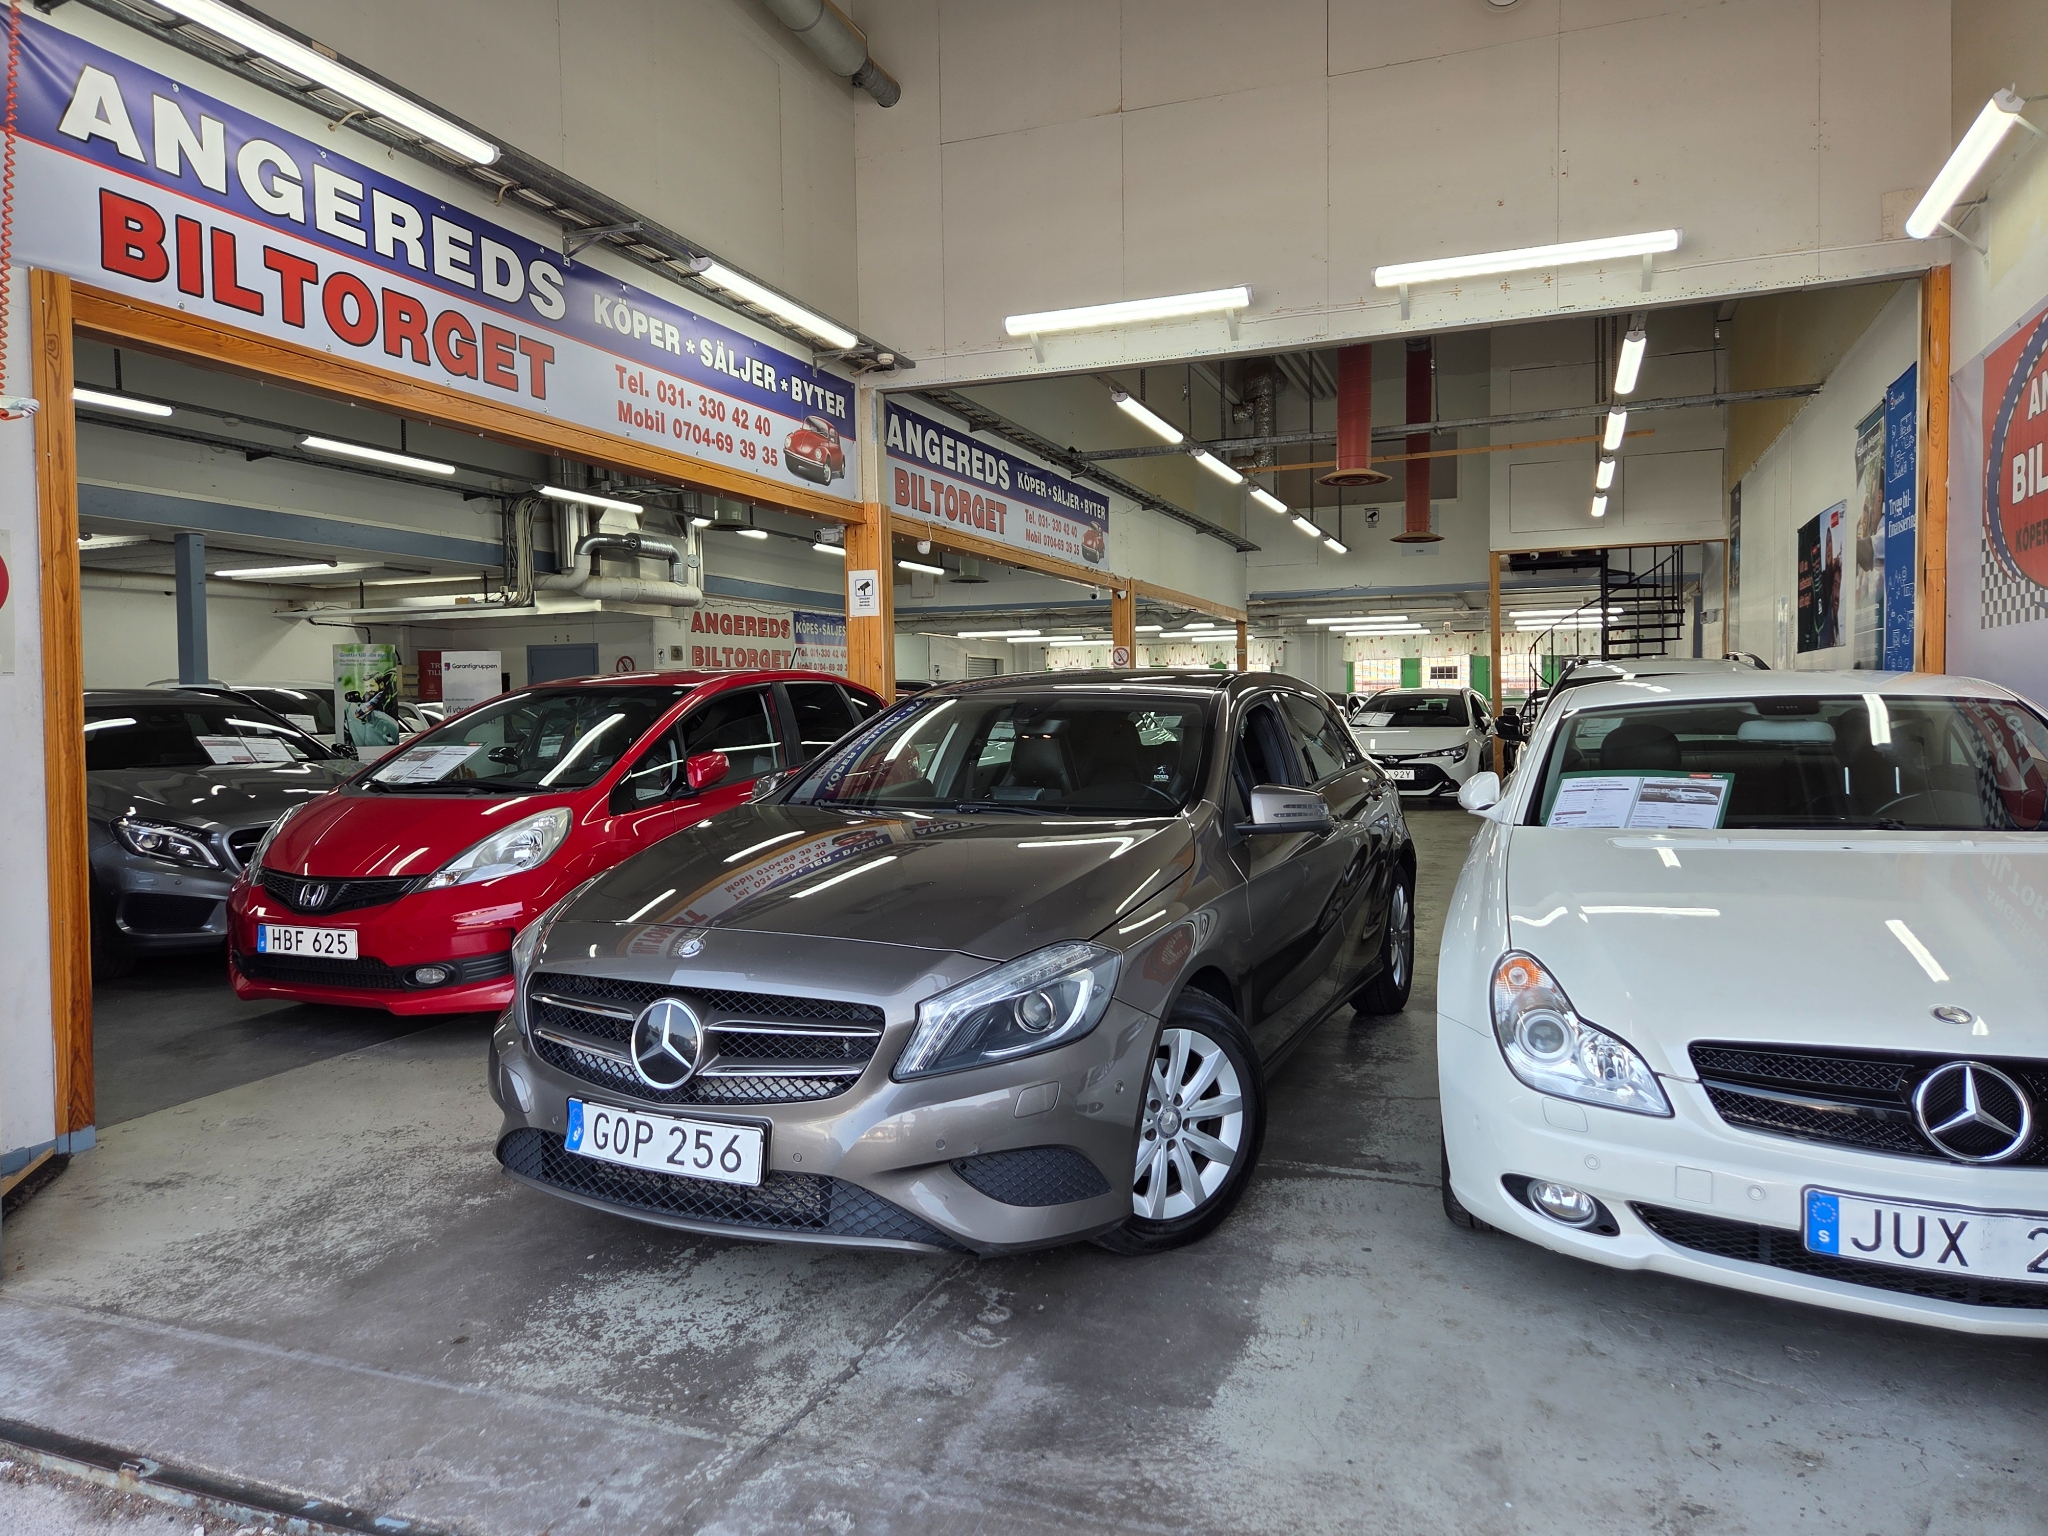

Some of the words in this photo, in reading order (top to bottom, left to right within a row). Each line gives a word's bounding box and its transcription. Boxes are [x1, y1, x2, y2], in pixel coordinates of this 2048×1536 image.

[58, 65, 566, 320] ANGEREDS
[99, 188, 554, 400] BILTORGET
[593, 294, 681, 356] KÖPER
[699, 339, 777, 393] SÄLJER
[790, 375, 846, 420] BYTER
[614, 364, 649, 398] Tel.
[656, 380, 692, 411] 031-
[698, 394, 726, 422] 330
[732, 407, 749, 430] 42
[755, 415, 771, 437] 40
[617, 400, 665, 434] Mobil
[672, 418, 734, 454] 0704-69
[740, 438, 756, 461] 39
[762, 446, 778, 467] 35
[886, 413, 1011, 491] ANGEREDS
[894, 467, 1007, 535] BILTORGET
[1017, 471, 1047, 498] KÖPER
[1052, 485, 1080, 511] SÄLJER
[1084, 499, 1106, 520] BYTER
[1025, 508, 1037, 525] Tel.
[1052, 518, 1062, 533] 330
[1063, 522, 1070, 536] 42
[1071, 525, 1078, 538] 40
[1025, 528, 1042, 544] Mobil
[1066, 541, 1073, 554] 39
[690, 611, 791, 640] ANGEREDS
[451, 662, 498, 670] Garantigruppen
[691, 645, 792, 669] BILTORGET
[1393, 770, 1411, 778] 92Y
[271, 928, 304, 951] HBF
[312, 932, 348, 955] 625
[593, 1112, 654, 1158] GOP
[666, 1126, 743, 1173] 256
[1818, 1229, 1830, 1243] S
[1850, 1208, 1969, 1267] JUX
